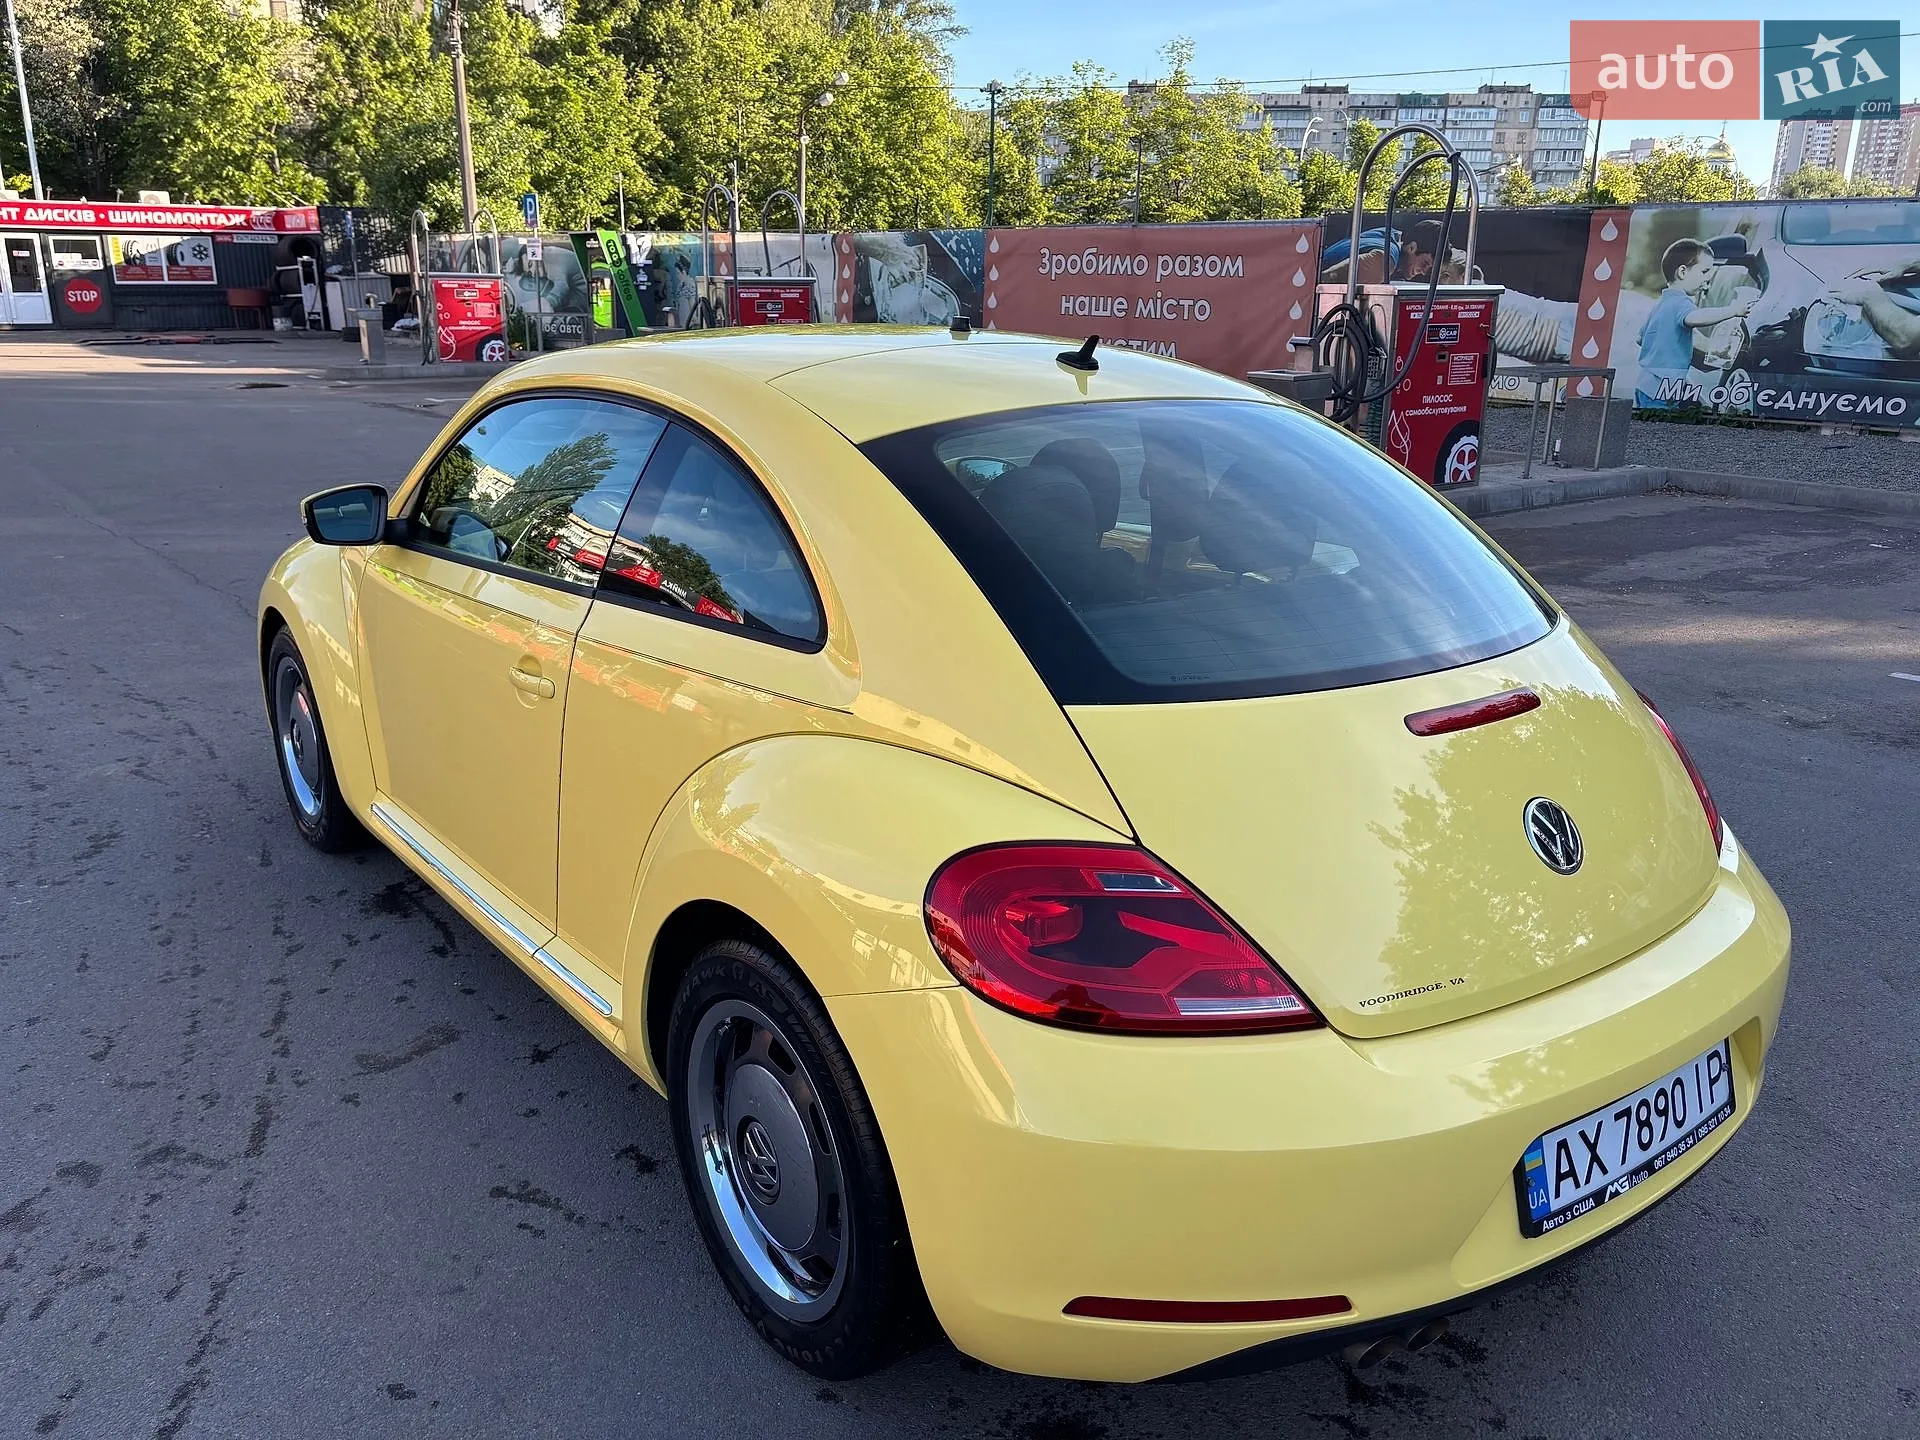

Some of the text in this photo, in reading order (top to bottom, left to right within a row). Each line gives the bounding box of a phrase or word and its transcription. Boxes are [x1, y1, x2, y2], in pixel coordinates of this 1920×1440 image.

[24, 208, 97, 222] ДИСКІВ
[108, 210, 248, 227] ШИНОМОНТАЖ
[1038, 248, 1245, 282] Зробимо разом
[67, 291, 98, 302] STOP
[1060, 290, 1212, 322] наше місто
[1422, 394, 1453, 404] ПИЛОСОС
[1655, 376, 1907, 416] Ми об'єднуємо
[1449, 977, 1465, 986] VA
[1554, 1049, 1723, 1200] AX 7890 IP
[1654, 1155, 1666, 1169] 067
[1666, 1147, 1678, 1161] 840
[1686, 1135, 1694, 1148] 34
[1708, 1117, 1718, 1131] 321
[1632, 1170, 1649, 1187] Auto
[1528, 1190, 1548, 1210] UA
[1572, 1197, 1596, 1216] США
